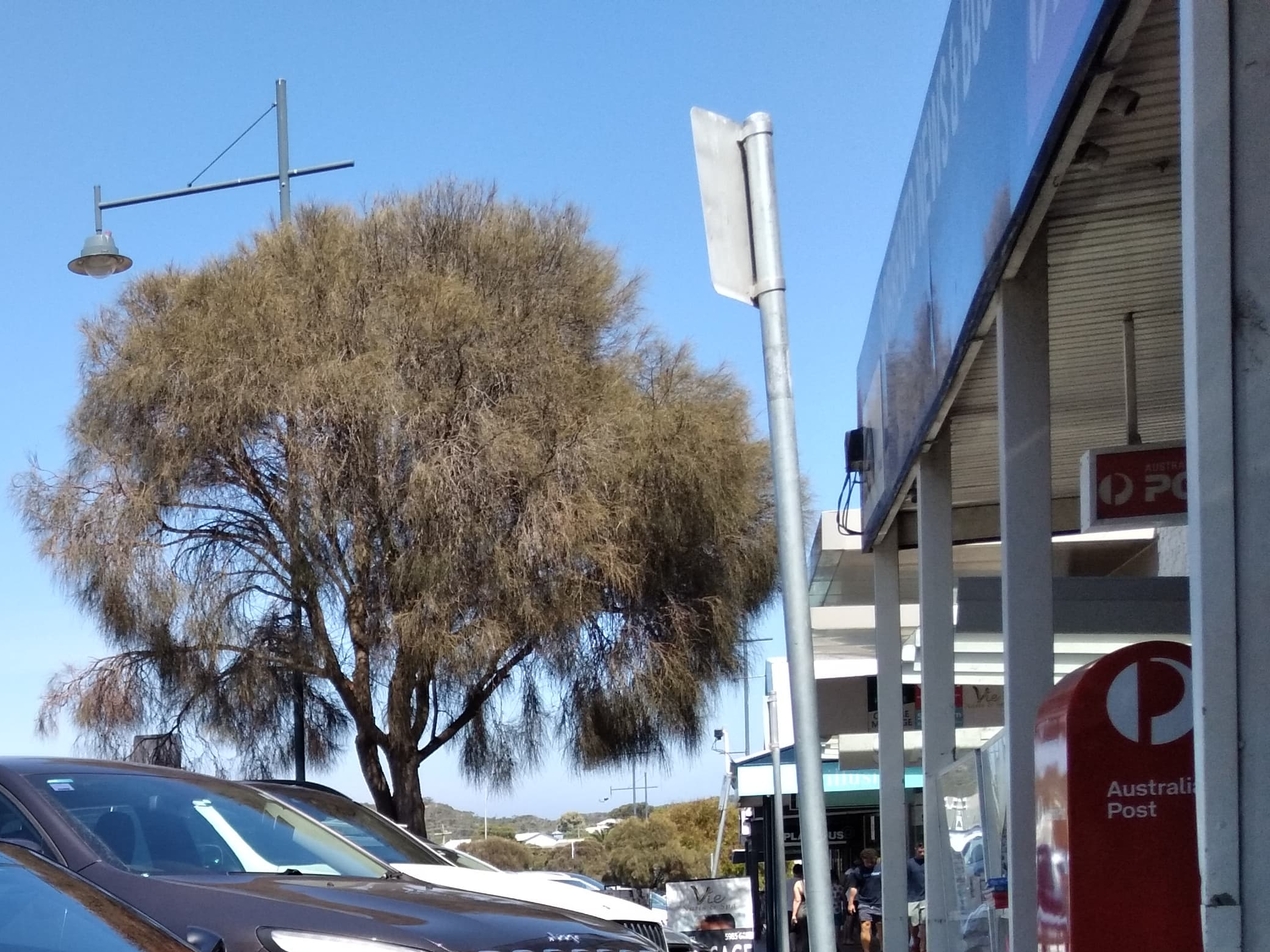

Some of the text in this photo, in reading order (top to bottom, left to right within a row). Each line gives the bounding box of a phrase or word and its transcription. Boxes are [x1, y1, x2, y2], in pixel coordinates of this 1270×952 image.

[914, 55, 950, 247] NEWS
[1145, 460, 1187, 472] AUSTRA
[1145, 471, 1188, 502] PO
[1107, 777, 1196, 798] Australi
[1107, 801, 1158, 819] Post
[690, 885, 726, 905] Vie
